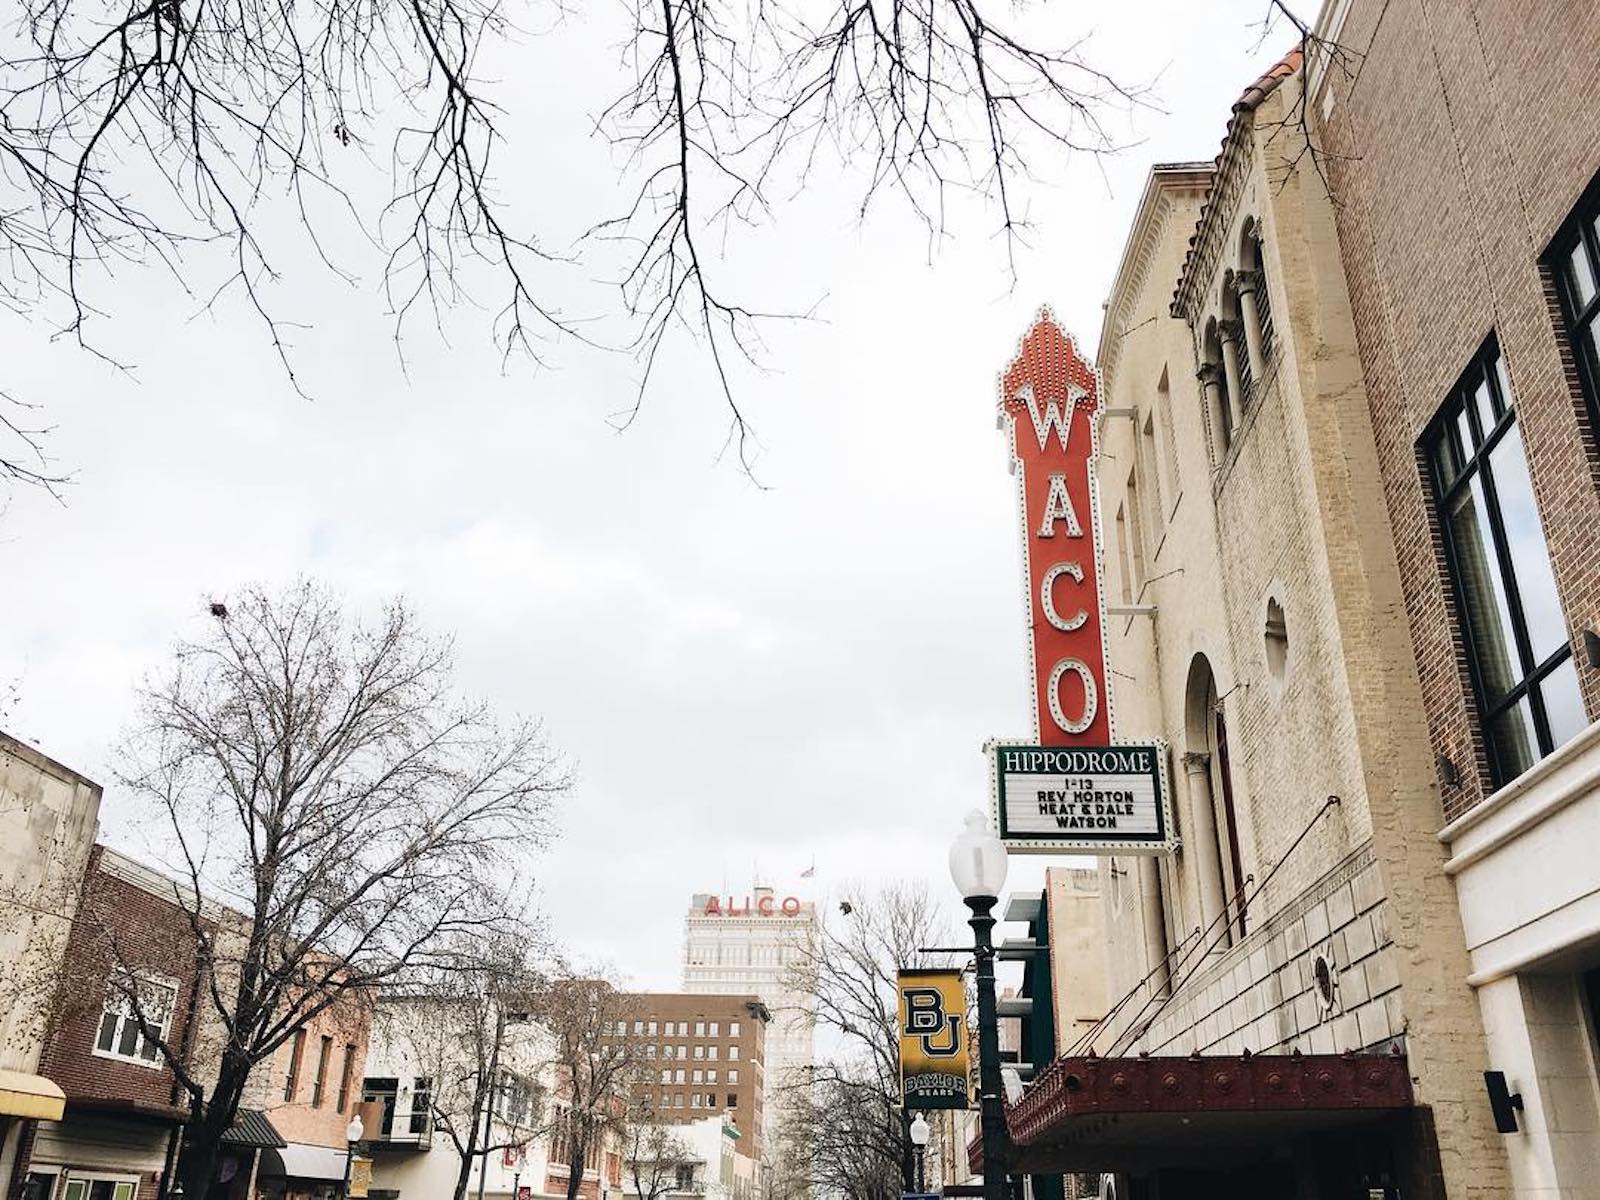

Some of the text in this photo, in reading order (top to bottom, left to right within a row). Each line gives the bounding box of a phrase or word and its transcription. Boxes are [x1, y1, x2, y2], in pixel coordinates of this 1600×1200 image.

[1017, 382, 1099, 735] WACO
[1004, 751, 1152, 773] HIPPODROME
[1037, 791, 1134, 803] REV HORTON
[1039, 804, 1134, 815] HEAT & DALE
[1056, 816, 1117, 829] WATSON
[704, 896, 800, 917] ALICO
[905, 1073, 967, 1095] BAYLOR
